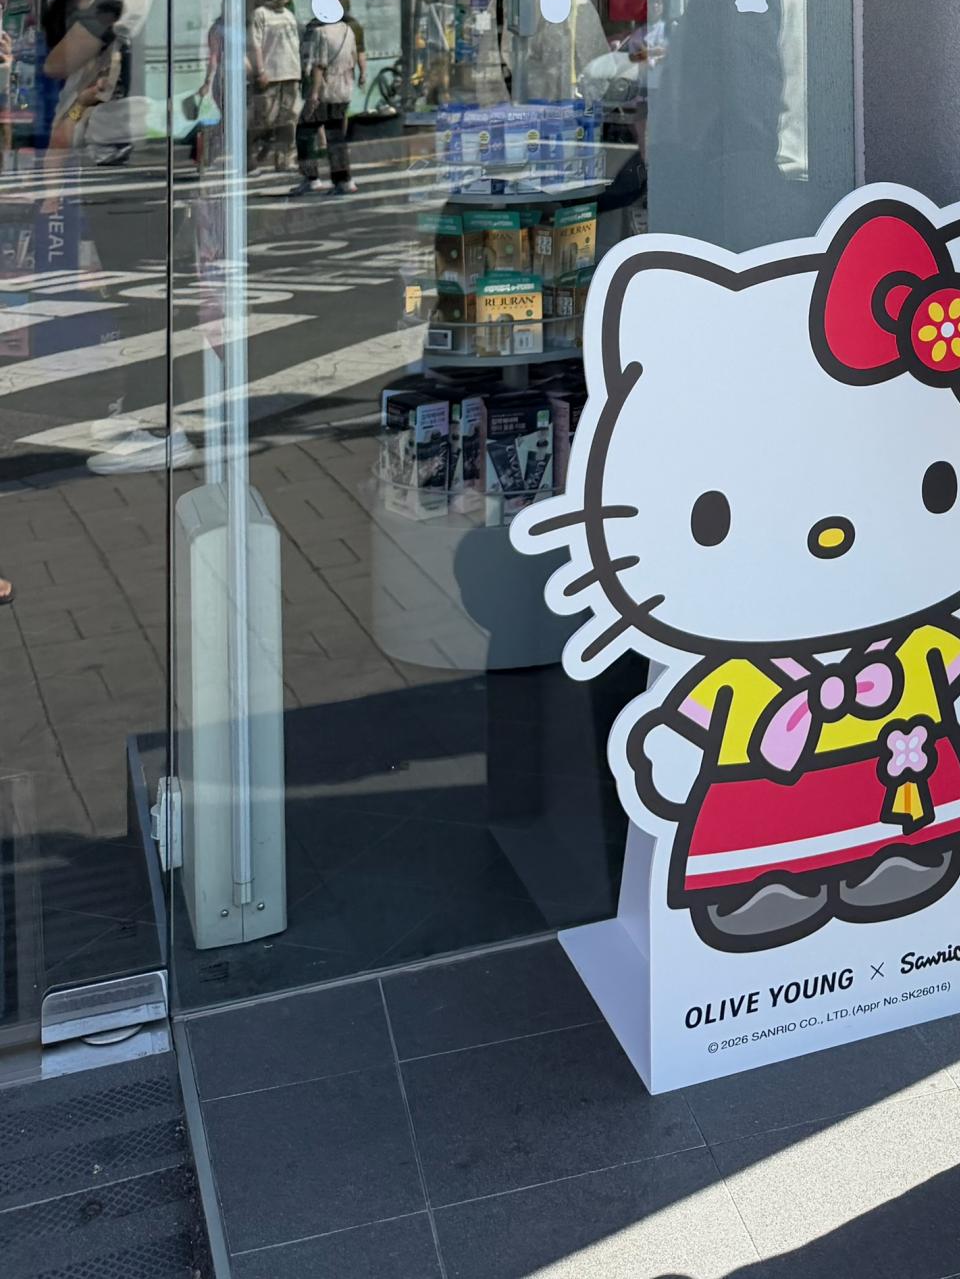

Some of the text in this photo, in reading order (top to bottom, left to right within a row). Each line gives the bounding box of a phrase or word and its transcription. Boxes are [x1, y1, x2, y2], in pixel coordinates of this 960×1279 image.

[684, 991, 760, 1029] OLIVE
[768, 967, 854, 1008] YOUNG
[720, 1035, 749, 1050] 2026
[751, 1022, 797, 1042] SANRIO
